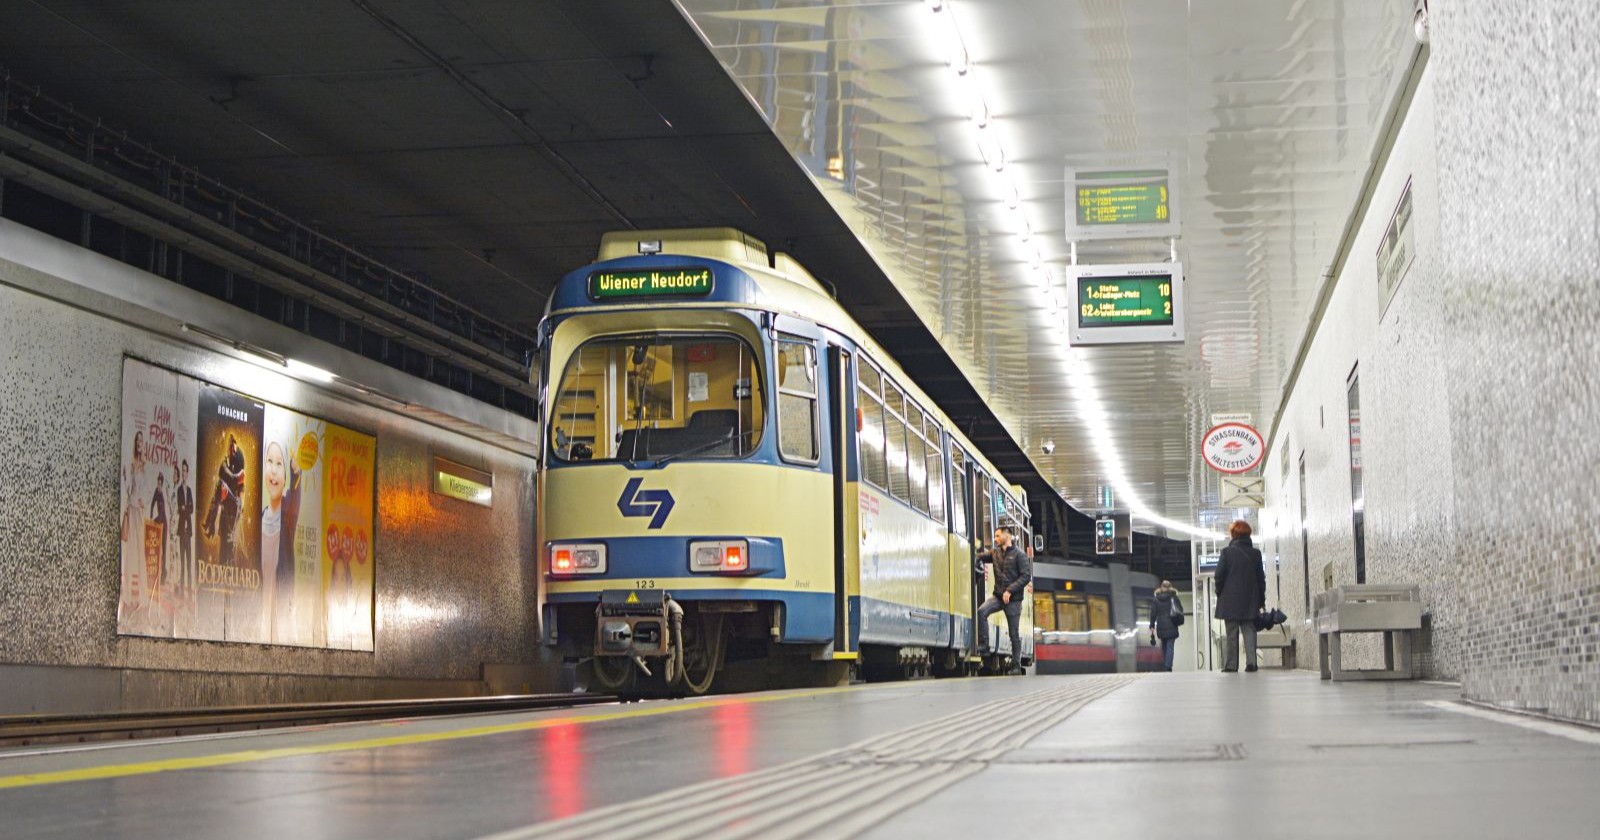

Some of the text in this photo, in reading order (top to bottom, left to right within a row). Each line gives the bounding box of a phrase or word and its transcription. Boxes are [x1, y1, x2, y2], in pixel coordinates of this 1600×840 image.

[600, 270, 708, 290] Wiener Neudorf
[1086, 285, 1093, 299] 1
[1099, 284, 1119, 293] Stefan
[1158, 283, 1170, 297] 10
[1081, 303, 1094, 317] 62
[1163, 301, 1171, 315] 2
[153, 404, 158, 422] I
[157, 404, 171, 427] AM
[149, 423, 176, 449] FROM
[1208, 429, 1257, 447] STRASSENBAHN
[143, 441, 179, 468] AUSTRIA
[1211, 453, 1256, 469] HALTESTELLE
[198, 559, 260, 590] BODYGUARD
[635, 579, 655, 589] 123
